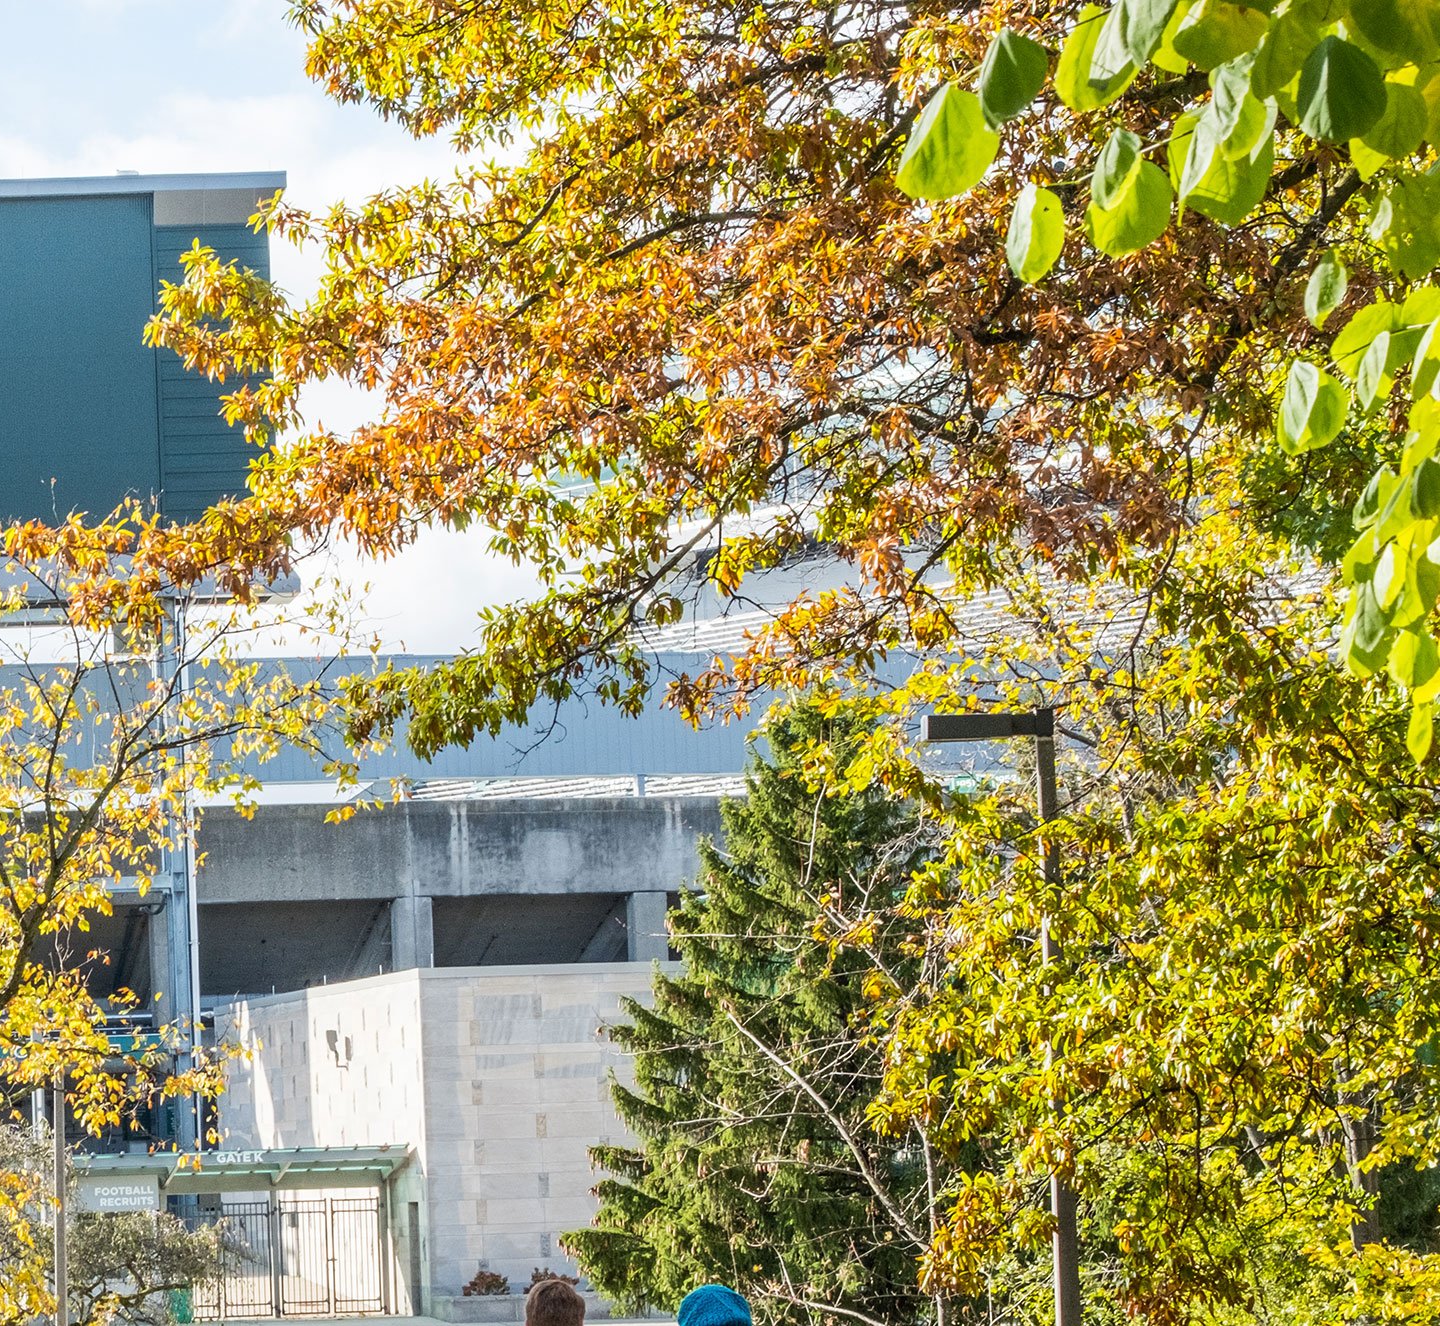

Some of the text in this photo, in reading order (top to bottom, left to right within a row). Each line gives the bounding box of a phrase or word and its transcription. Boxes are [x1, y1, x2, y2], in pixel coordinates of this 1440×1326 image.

[216, 1152, 264, 1164] GATE K
[94, 1185, 154, 1196] FOOTBALL
[99, 1196, 154, 1207] RECRUITS
